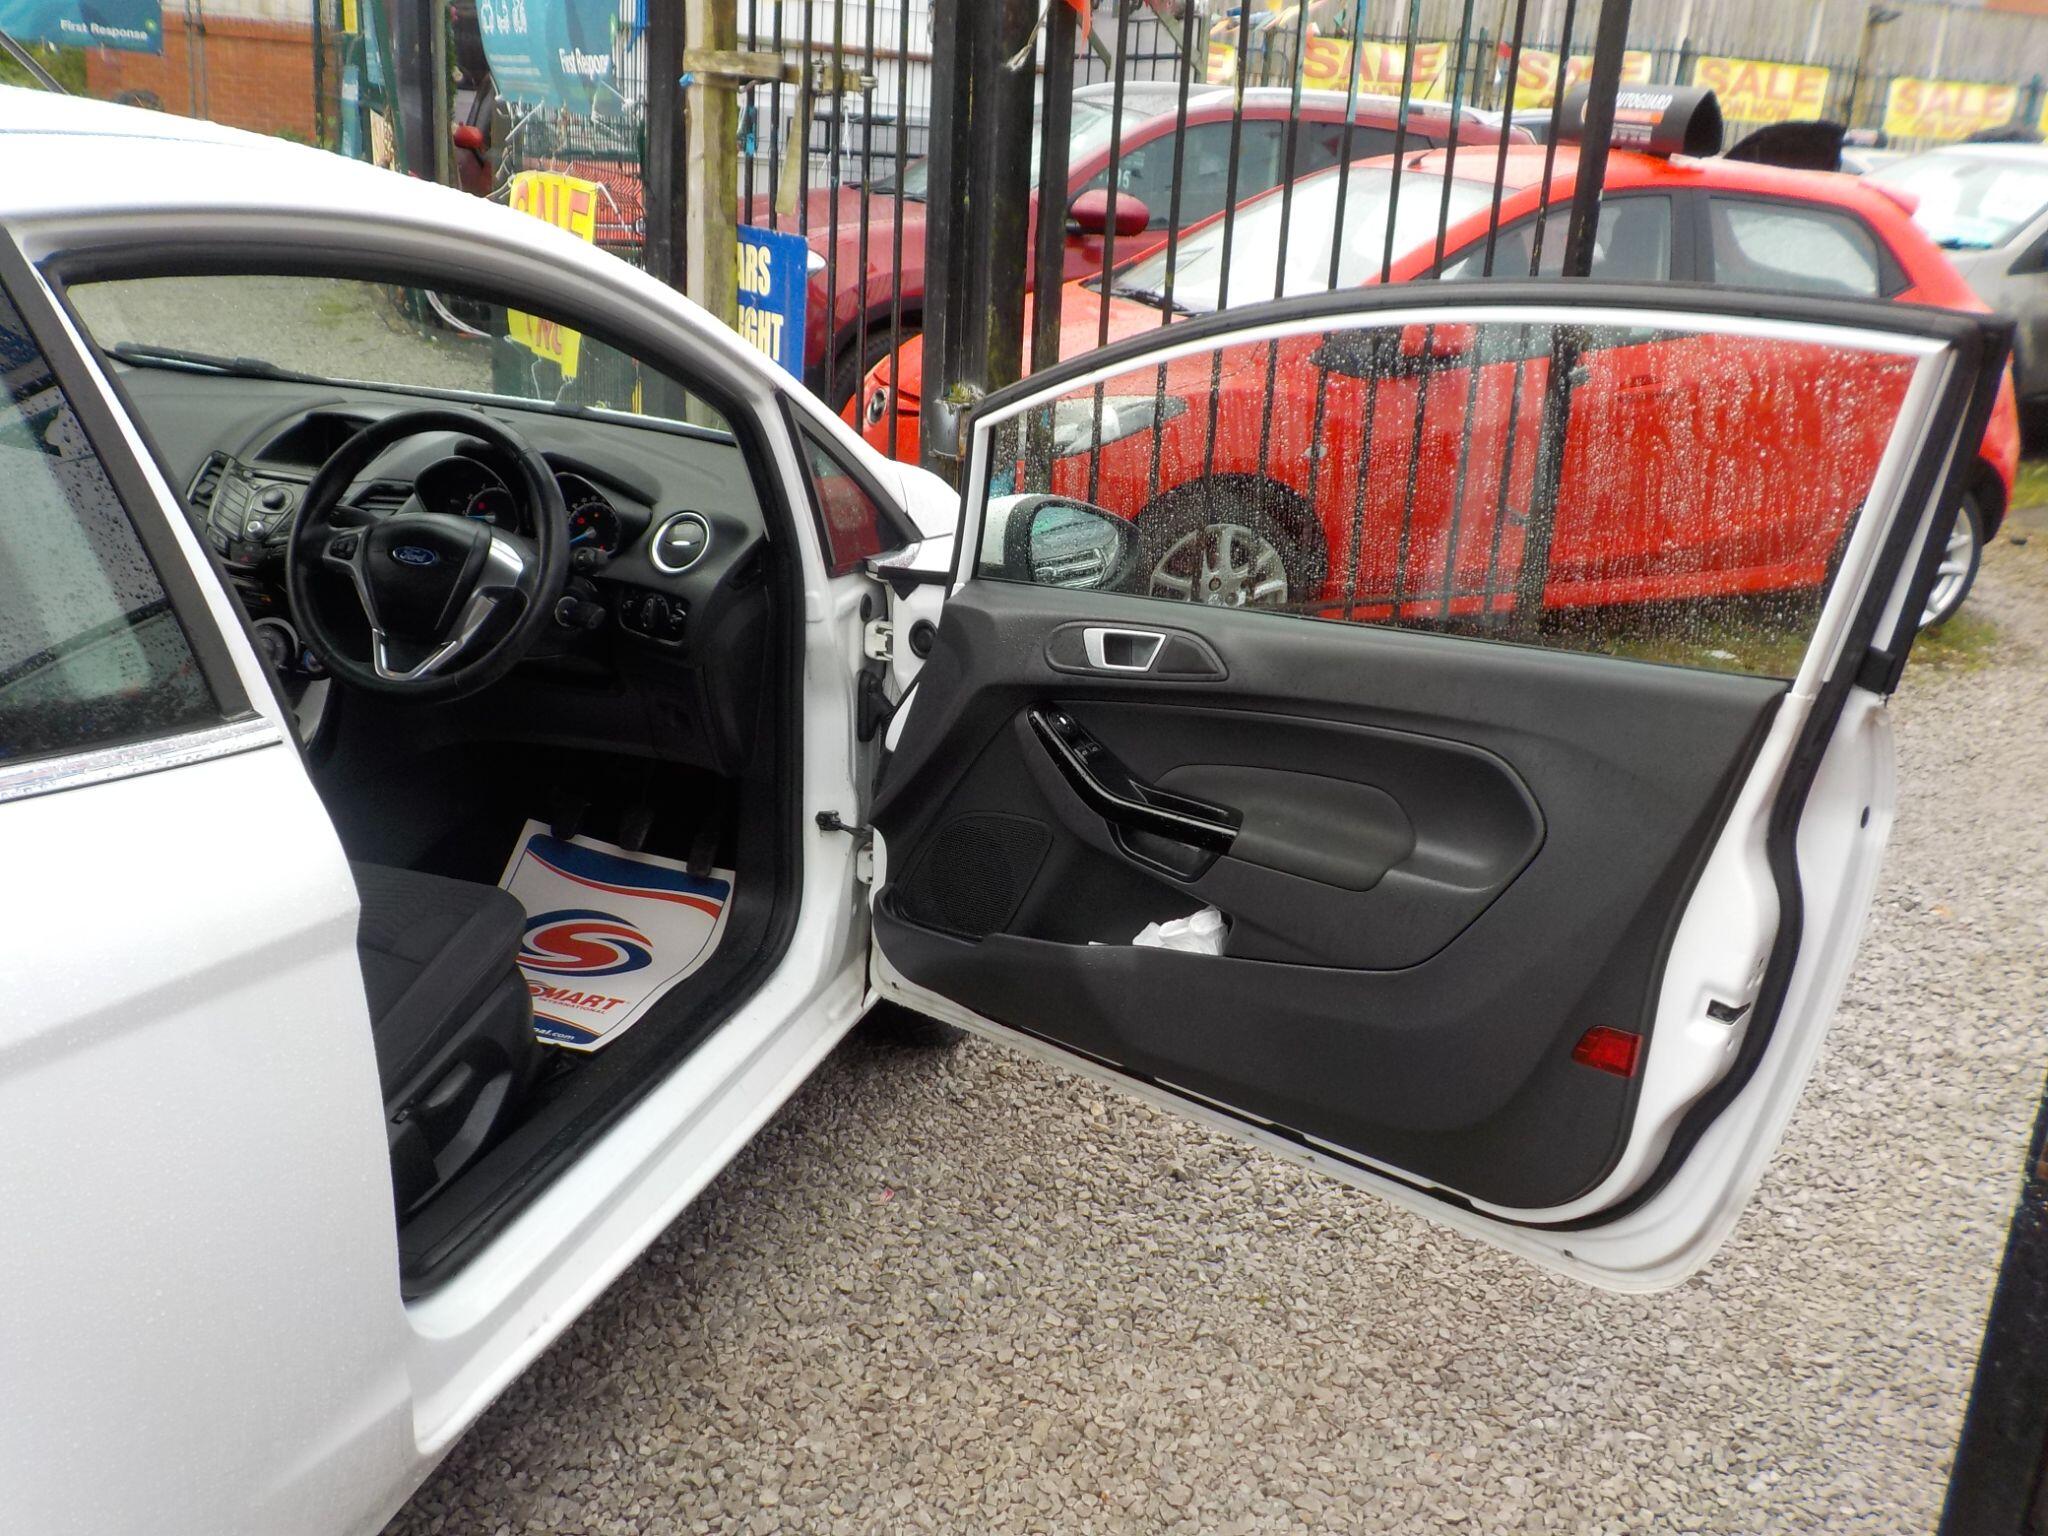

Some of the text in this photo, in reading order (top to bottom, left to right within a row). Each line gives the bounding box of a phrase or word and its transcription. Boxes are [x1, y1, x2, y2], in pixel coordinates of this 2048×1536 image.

[60, 19, 148, 40] First Response
[1303, 37, 1443, 83] SALE
[1699, 57, 1826, 106] SALE
[1897, 80, 2012, 119] SALE
[1615, 92, 1673, 111] UTOGUARD
[737, 241, 771, 296] ARS
[533, 1027, 575, 1040] nal.com
